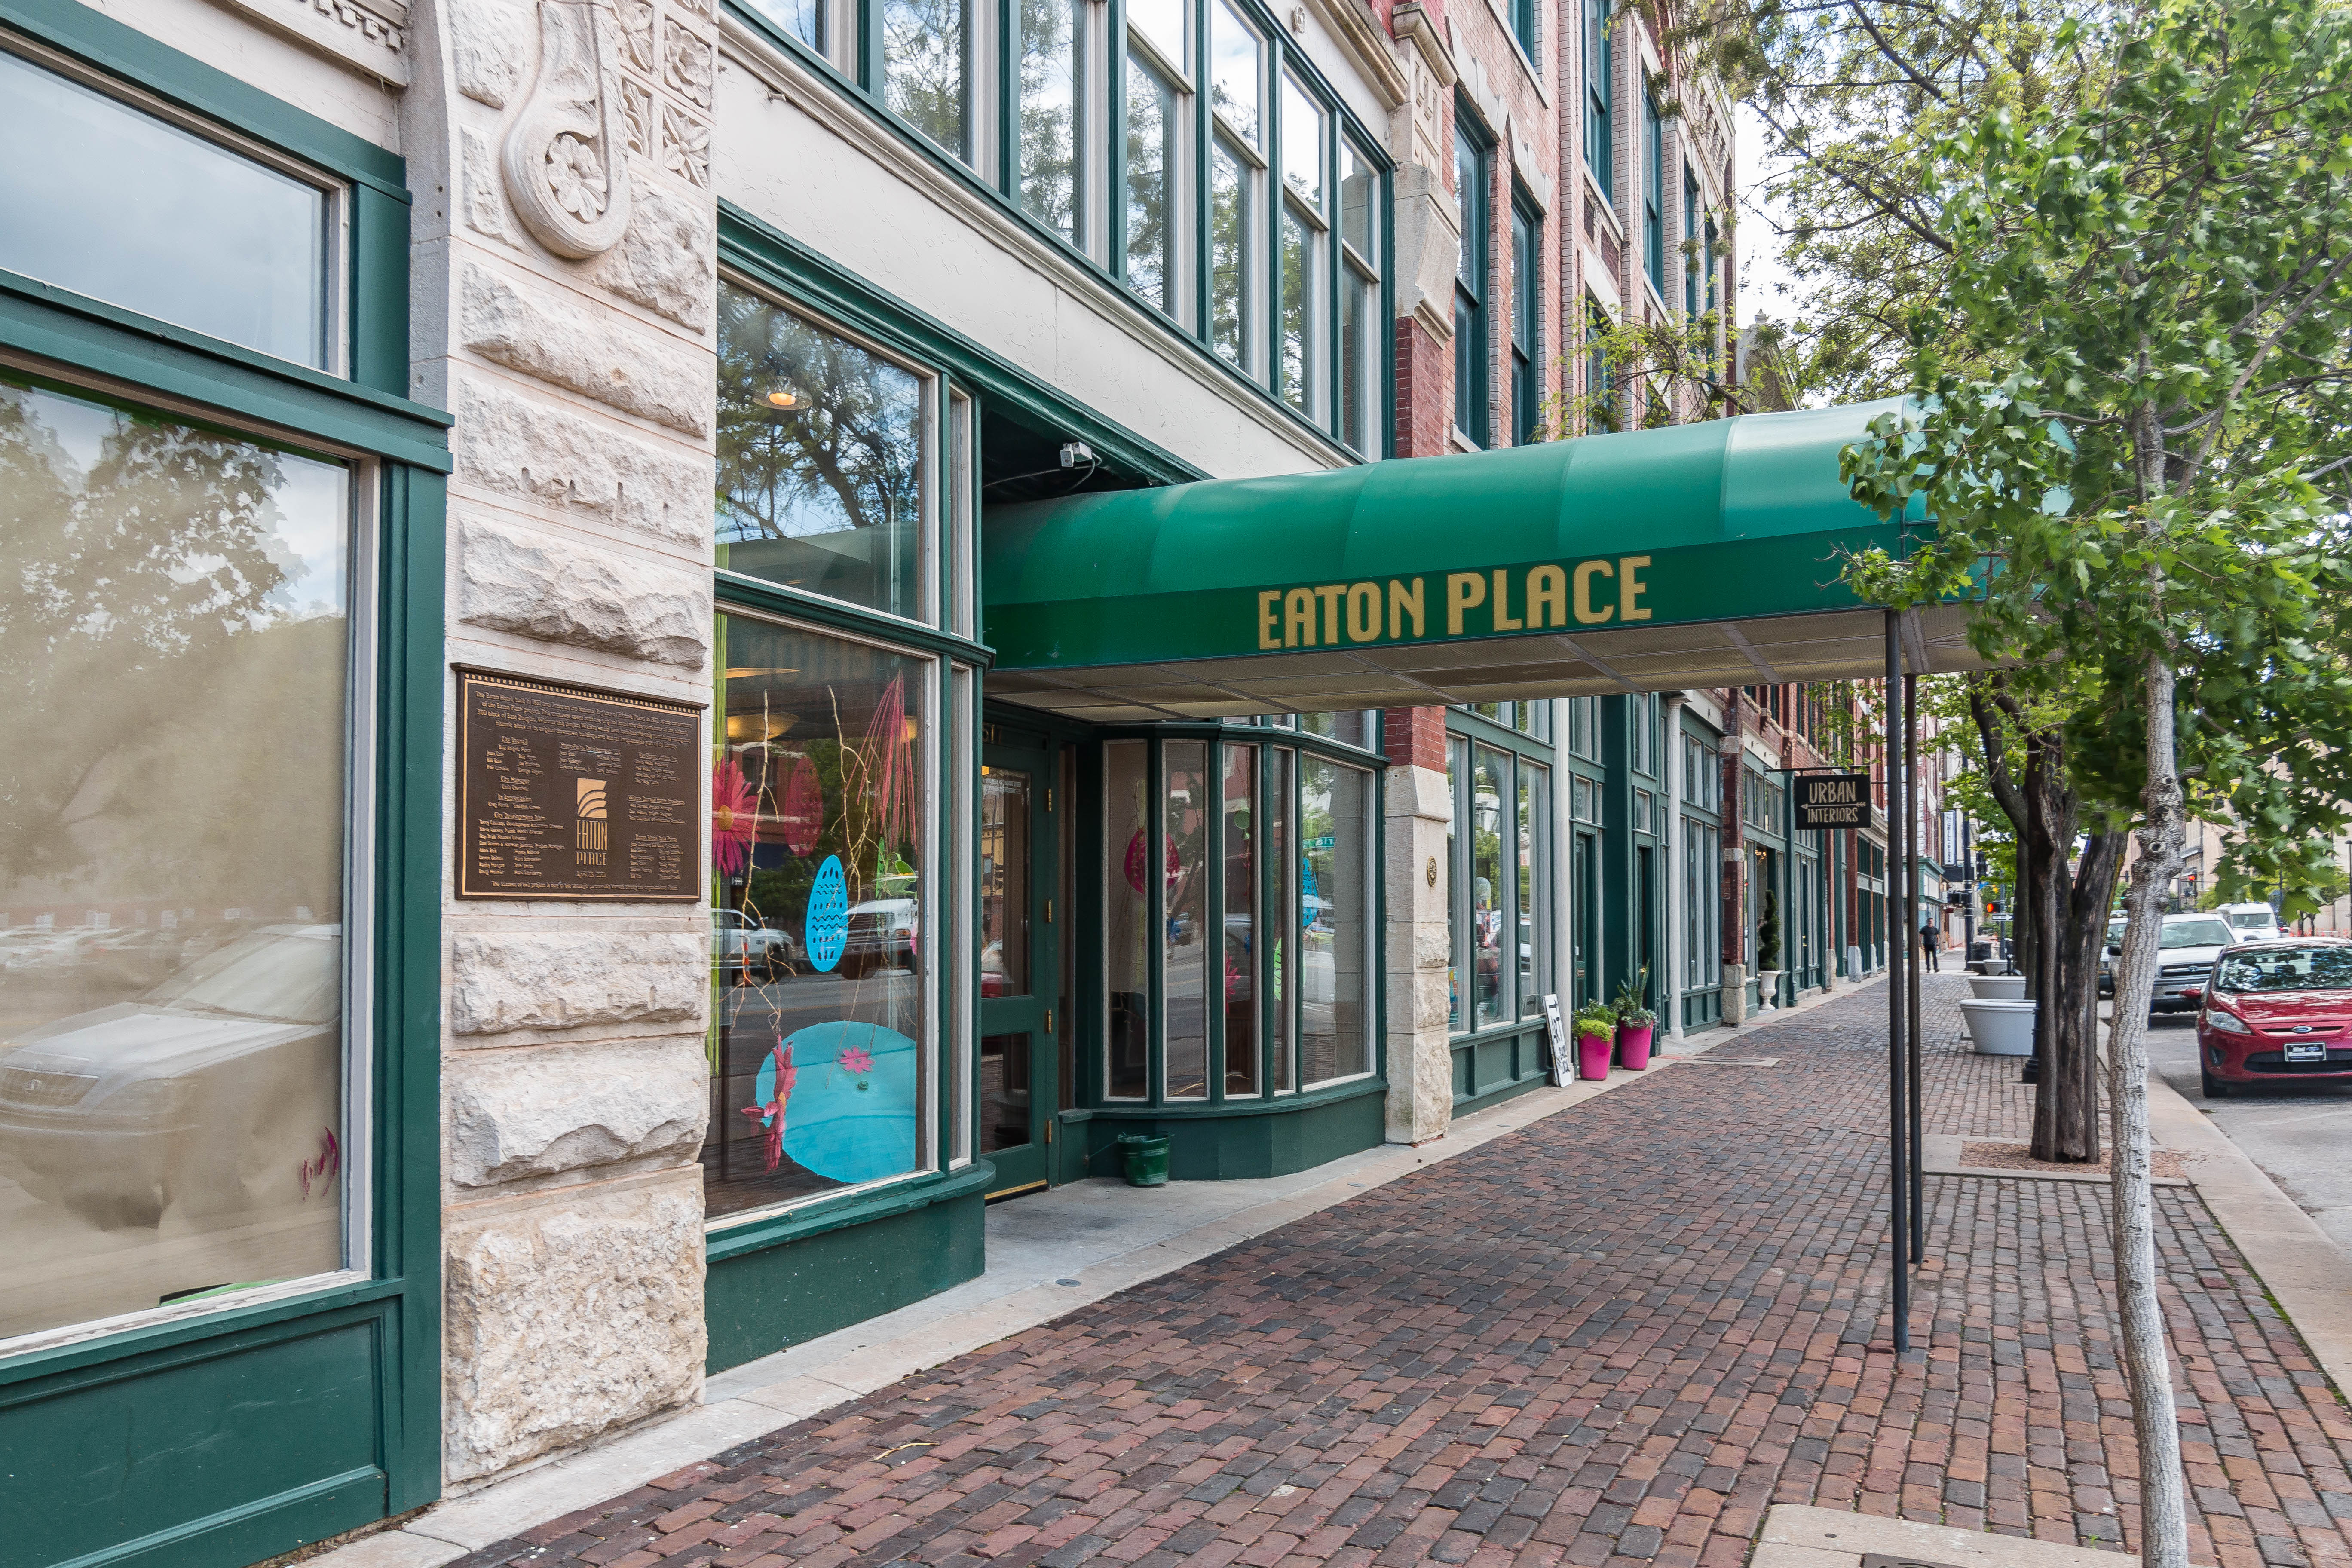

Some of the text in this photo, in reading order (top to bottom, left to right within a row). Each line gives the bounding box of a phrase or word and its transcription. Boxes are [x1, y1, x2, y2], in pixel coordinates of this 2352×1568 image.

[1259, 555, 1652, 649] EATON PLACE
[1809, 781, 1856, 803] URBAN
[1807, 808, 1858, 823] INTERIORS
[576, 820, 607, 850] EATON
[576, 851, 607, 865] PLACE
